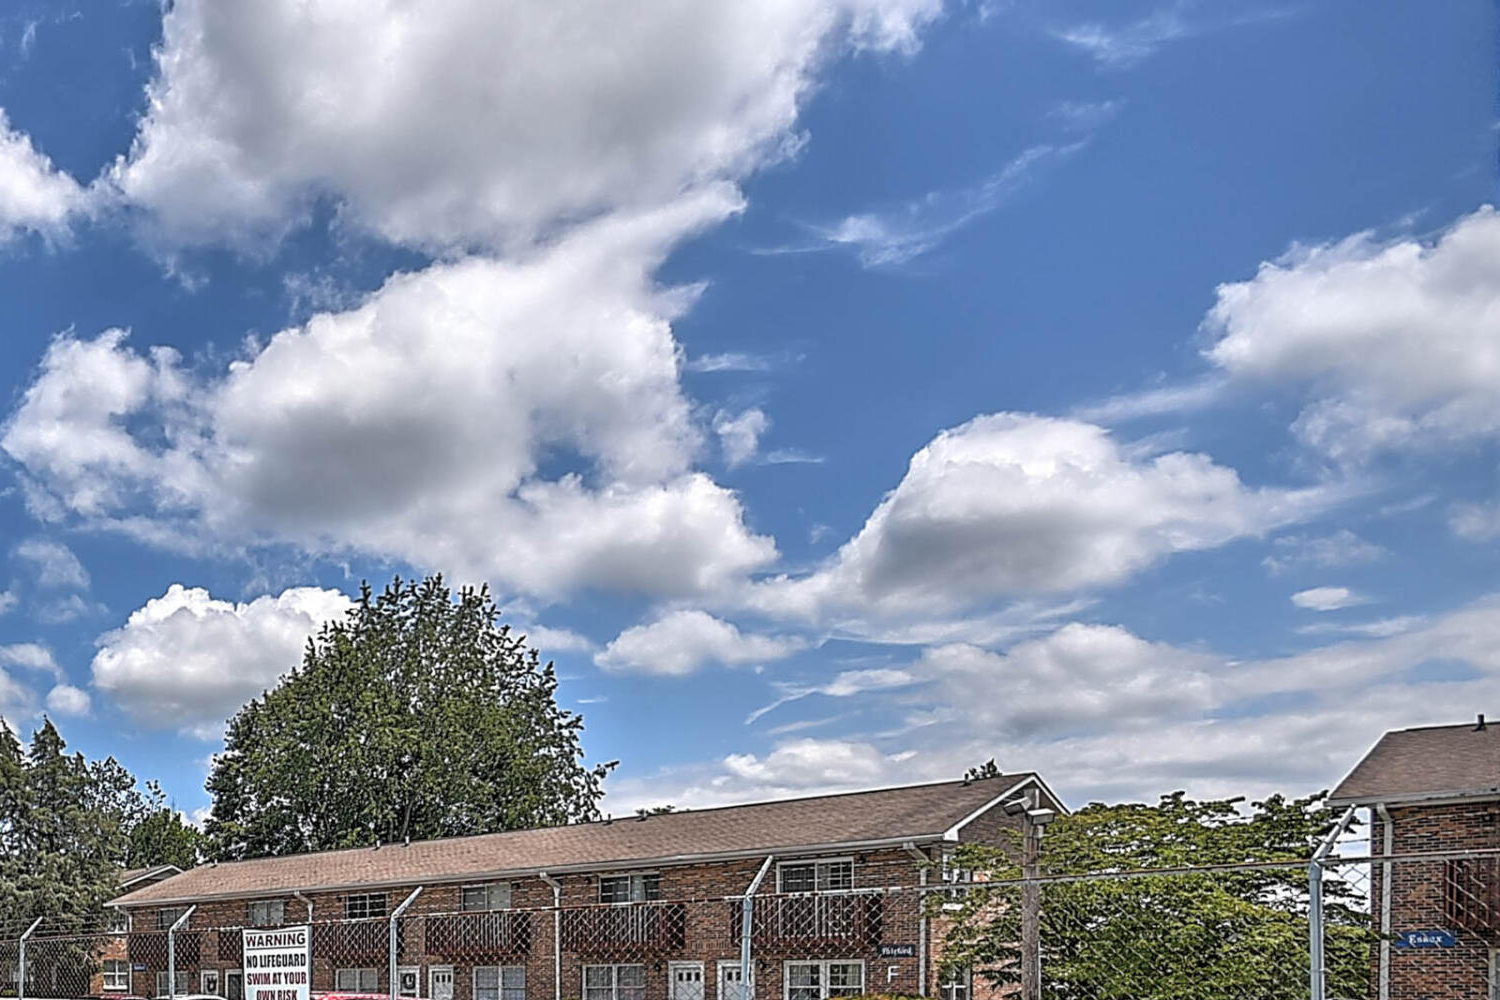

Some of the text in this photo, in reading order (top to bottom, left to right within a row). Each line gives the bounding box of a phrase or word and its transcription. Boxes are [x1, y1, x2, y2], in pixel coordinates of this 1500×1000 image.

[246, 933, 306, 947] WARNING
[246, 953, 307, 968] NO LIFEGUARD
[247, 972, 307, 985] SWIM AT YOUR
[886, 965, 901, 983] F
